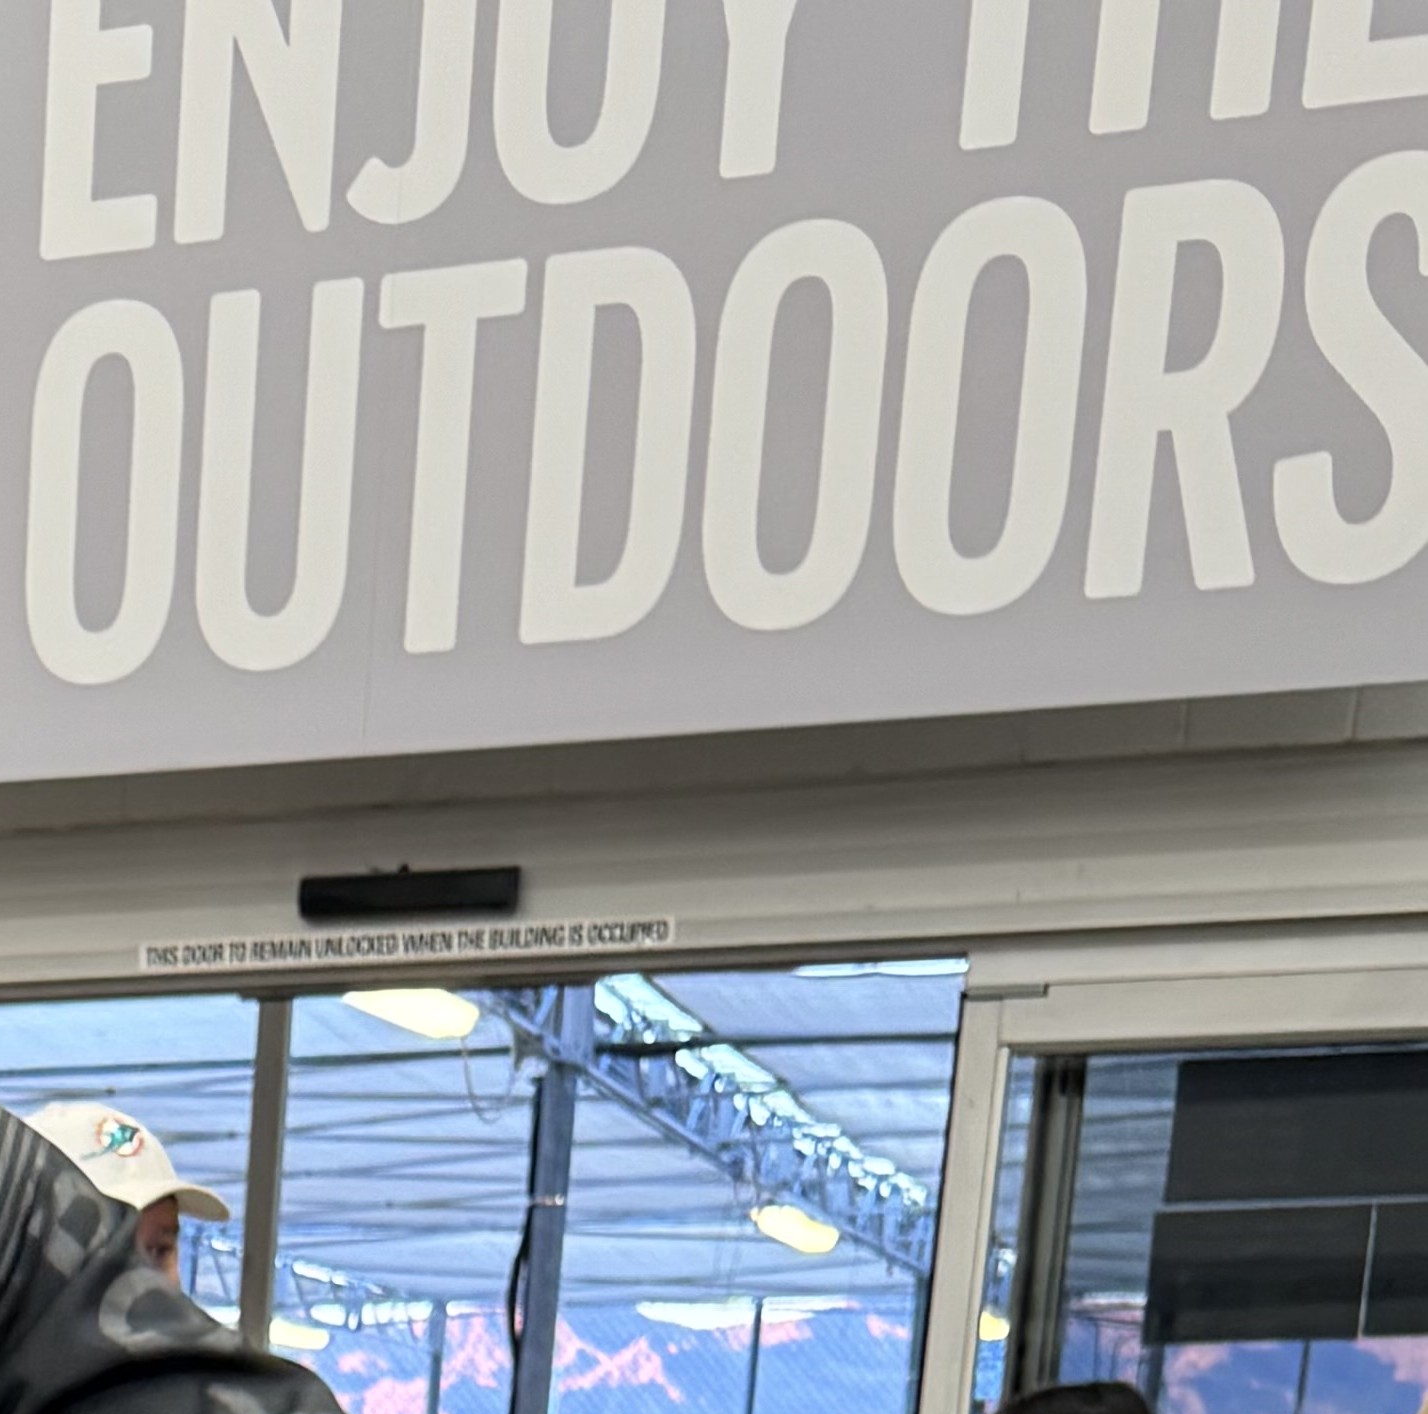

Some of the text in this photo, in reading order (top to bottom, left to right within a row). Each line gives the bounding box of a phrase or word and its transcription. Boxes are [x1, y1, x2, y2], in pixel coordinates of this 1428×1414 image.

[25, 150, 1428, 685] OUTDOORS
[182, 943, 223, 965] DOOR
[229, 941, 246, 963] TO
[251, 938, 311, 961] REMAIN
[315, 933, 400, 959] UNLOCKED
[402, 931, 453, 953] WHEN
[457, 927, 485, 949] THE
[488, 923, 565, 950] BUILDING
[569, 923, 583, 946] IS
[587, 919, 670, 946] OCCUPIED
